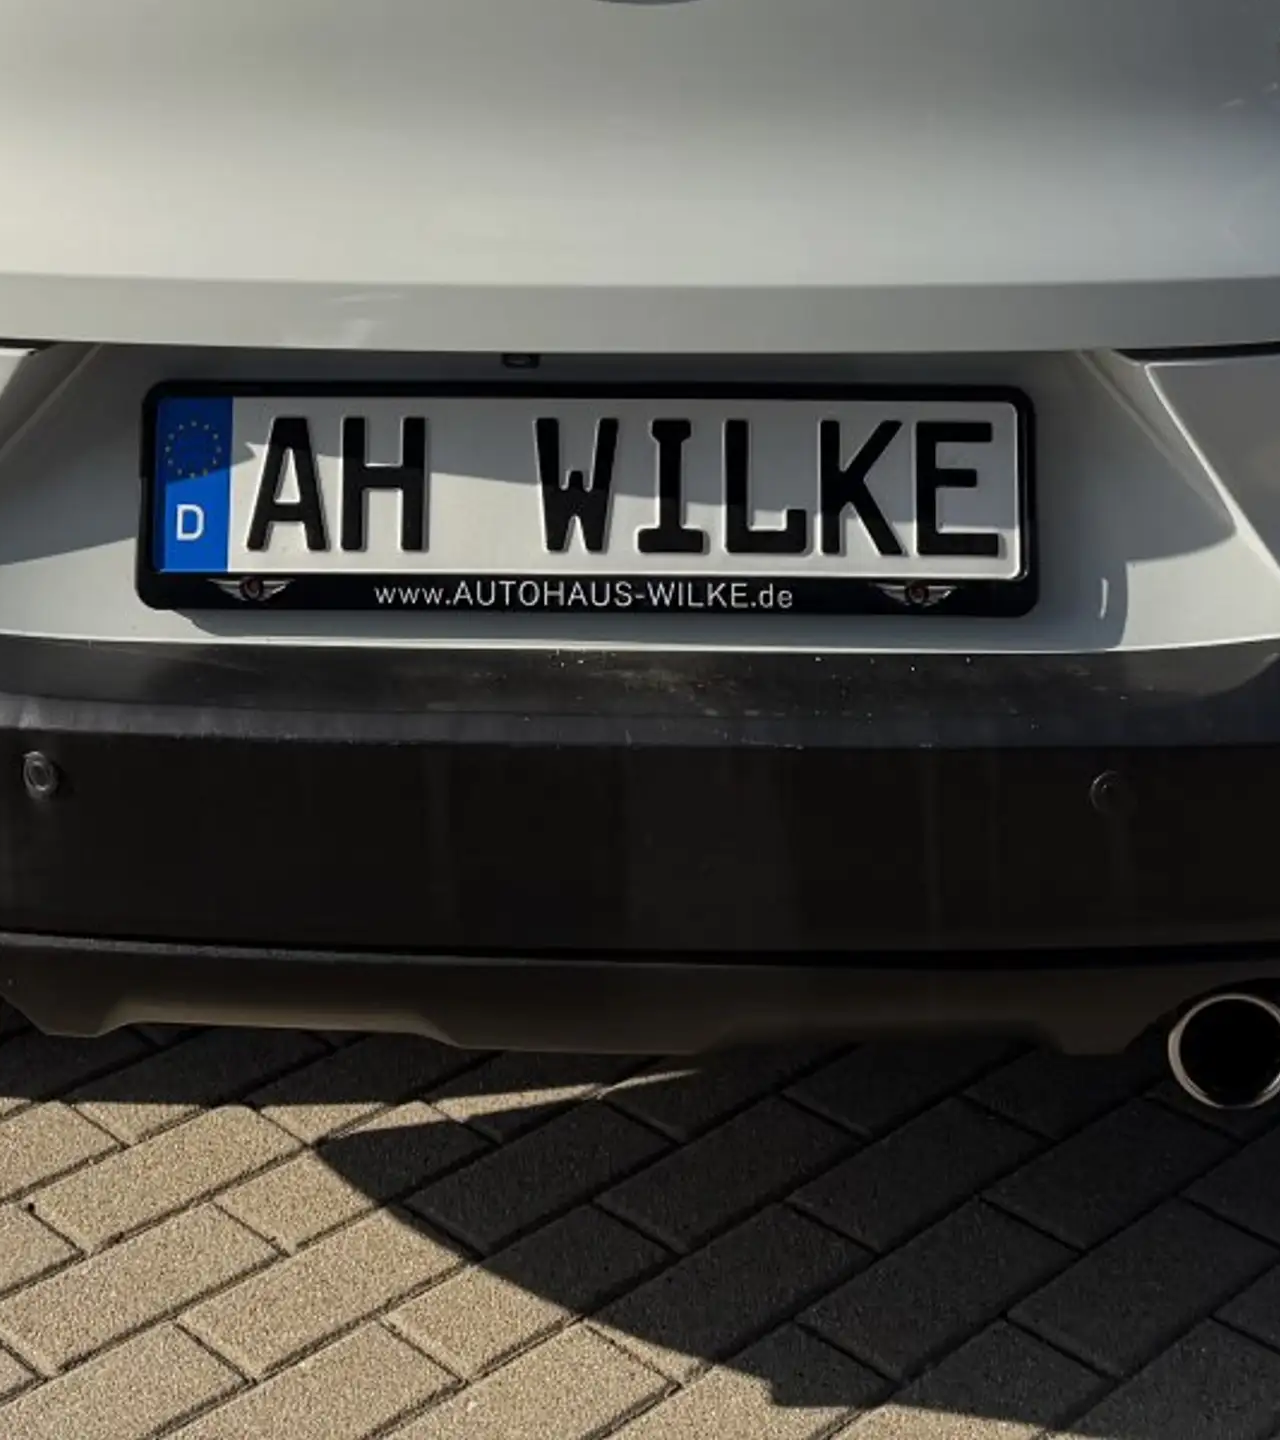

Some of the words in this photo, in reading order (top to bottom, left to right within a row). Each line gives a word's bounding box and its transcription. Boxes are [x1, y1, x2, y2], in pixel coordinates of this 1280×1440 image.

[176, 504, 205, 541] D
[246, 417, 427, 552] AH
[535, 417, 1000, 556] WILKE
[374, 580, 794, 609] www.AUTOHAUS-WILKE.de
